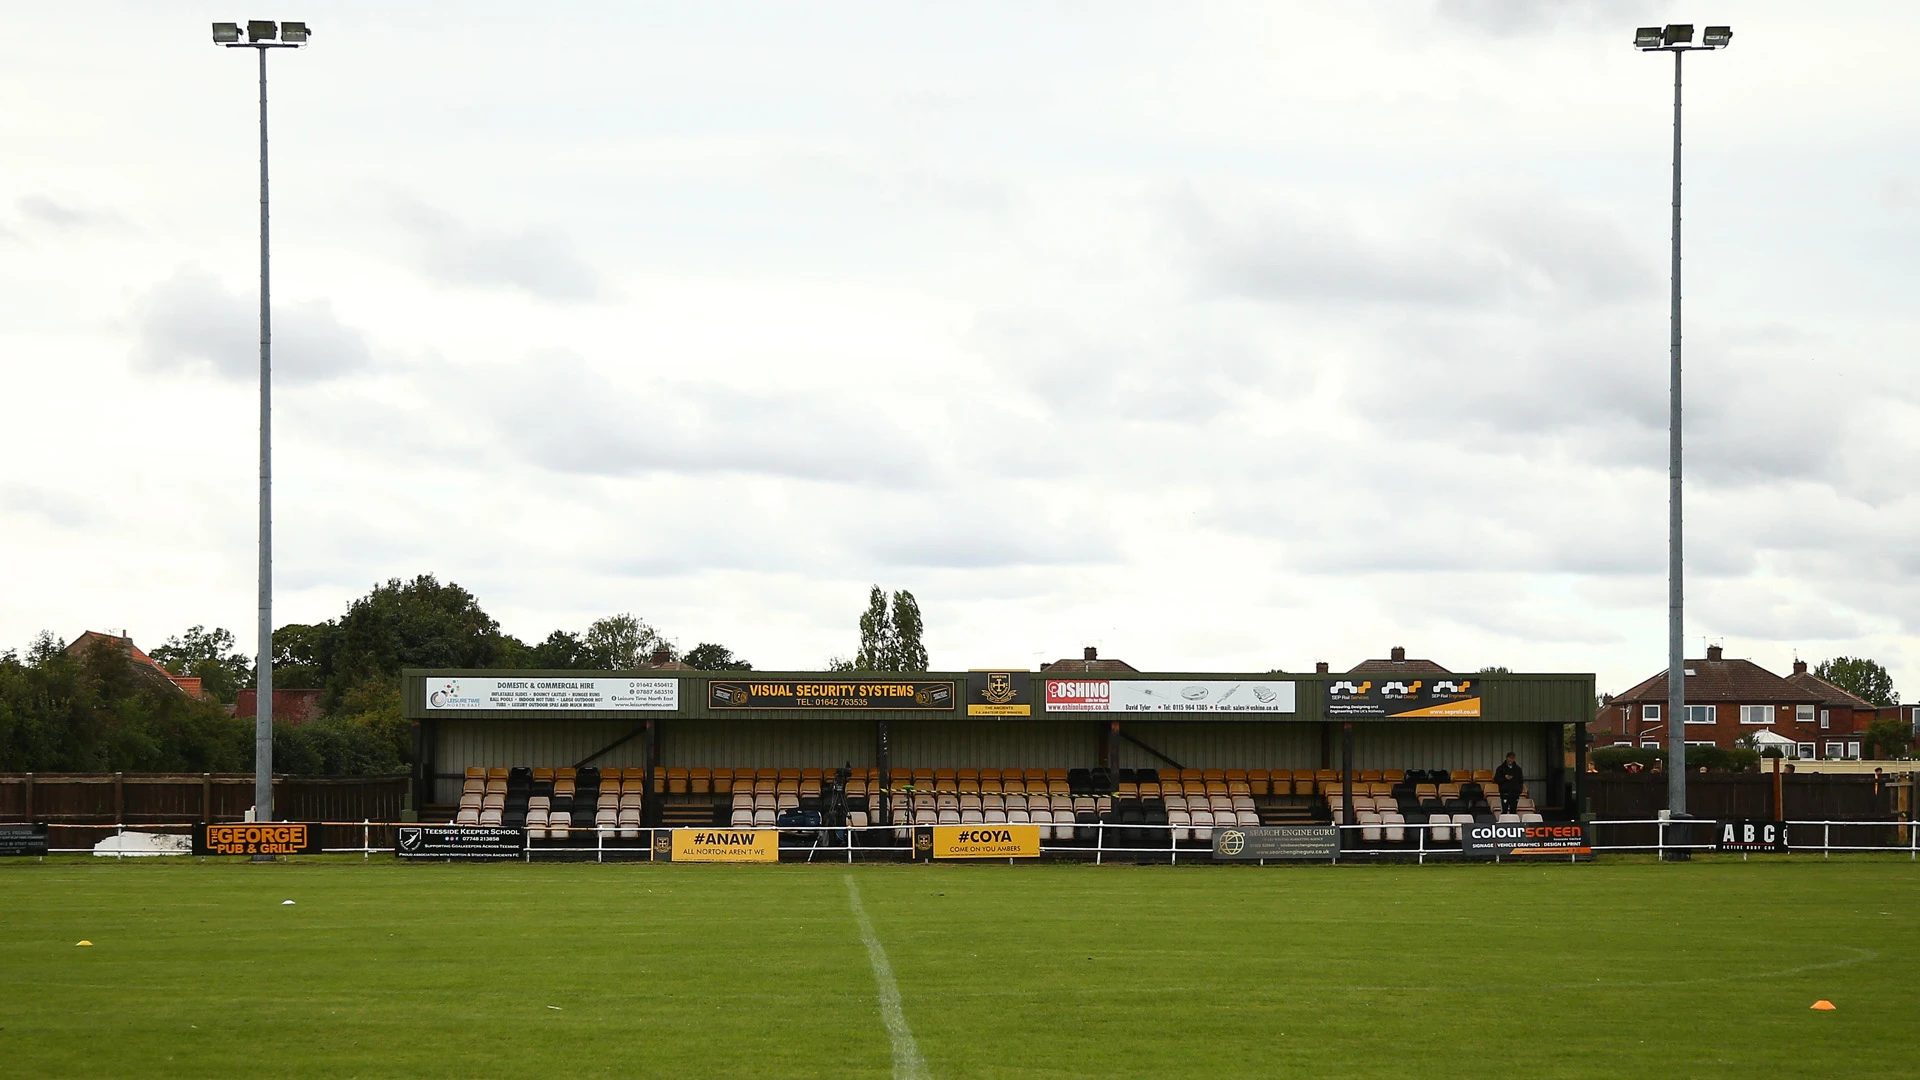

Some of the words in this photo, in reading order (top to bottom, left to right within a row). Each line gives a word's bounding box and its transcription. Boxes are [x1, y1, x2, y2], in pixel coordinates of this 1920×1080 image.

[750, 685, 793, 696] VISUAL
[796, 685, 856, 696] SECURITY
[859, 685, 914, 696] SYSTEMS
[1058, 682, 1108, 698] OSHINO
[217, 828, 303, 843] GEORGE
[959, 830, 1012, 843] #COYA
[1472, 825, 1581, 838] colourscreen
[694, 833, 755, 845] #ANAW
[217, 844, 244, 854] PUB
[247, 844, 257, 854] &
[260, 844, 297, 854] GRILL
